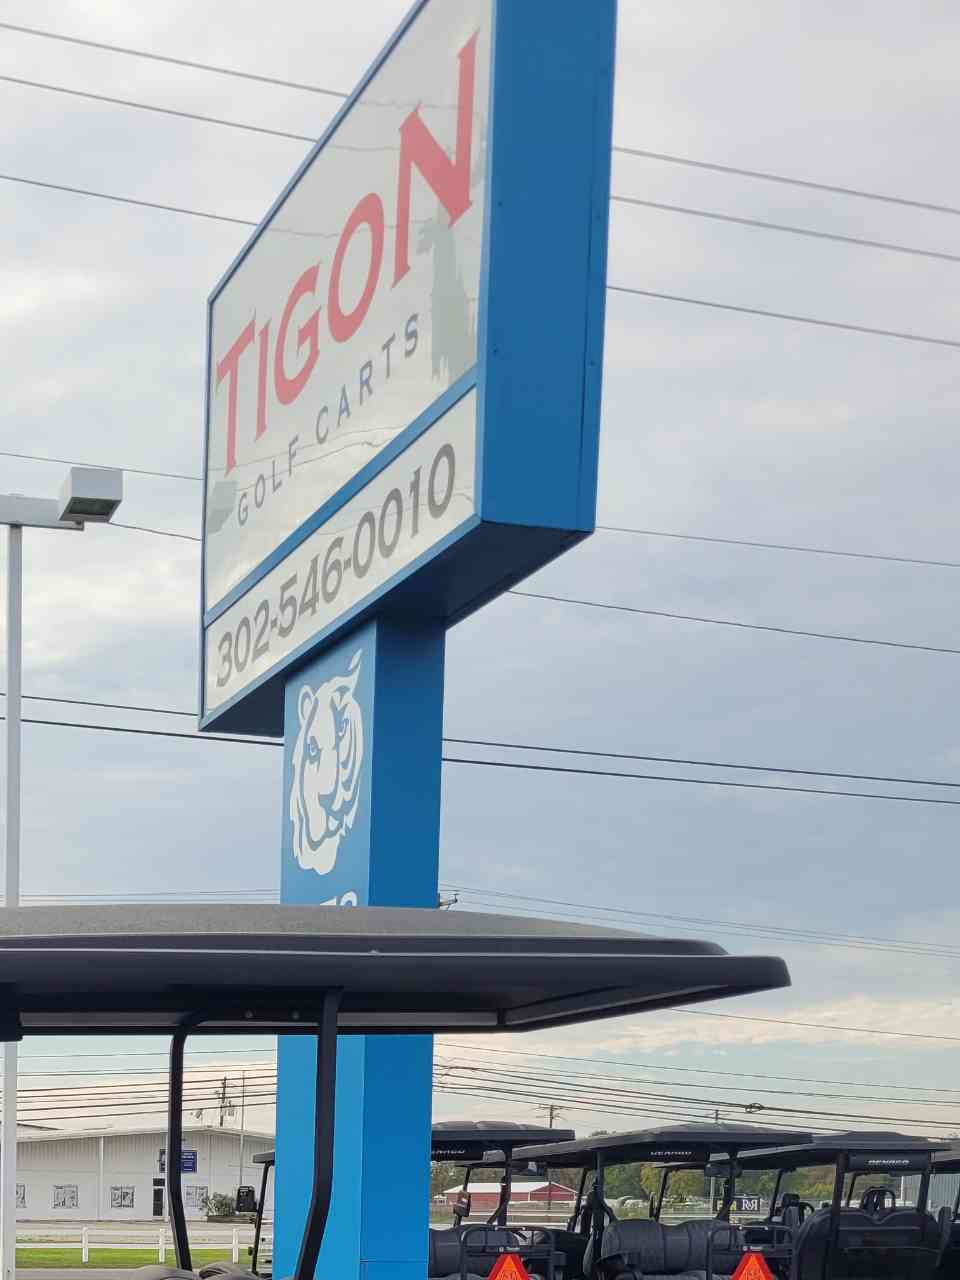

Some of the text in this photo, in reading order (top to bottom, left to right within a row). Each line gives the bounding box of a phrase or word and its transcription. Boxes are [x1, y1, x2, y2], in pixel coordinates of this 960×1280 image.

[216, 26, 479, 478] TIGON
[237, 312, 419, 527] GOLF CARTS
[216, 443, 456, 688] 302-546-0010
